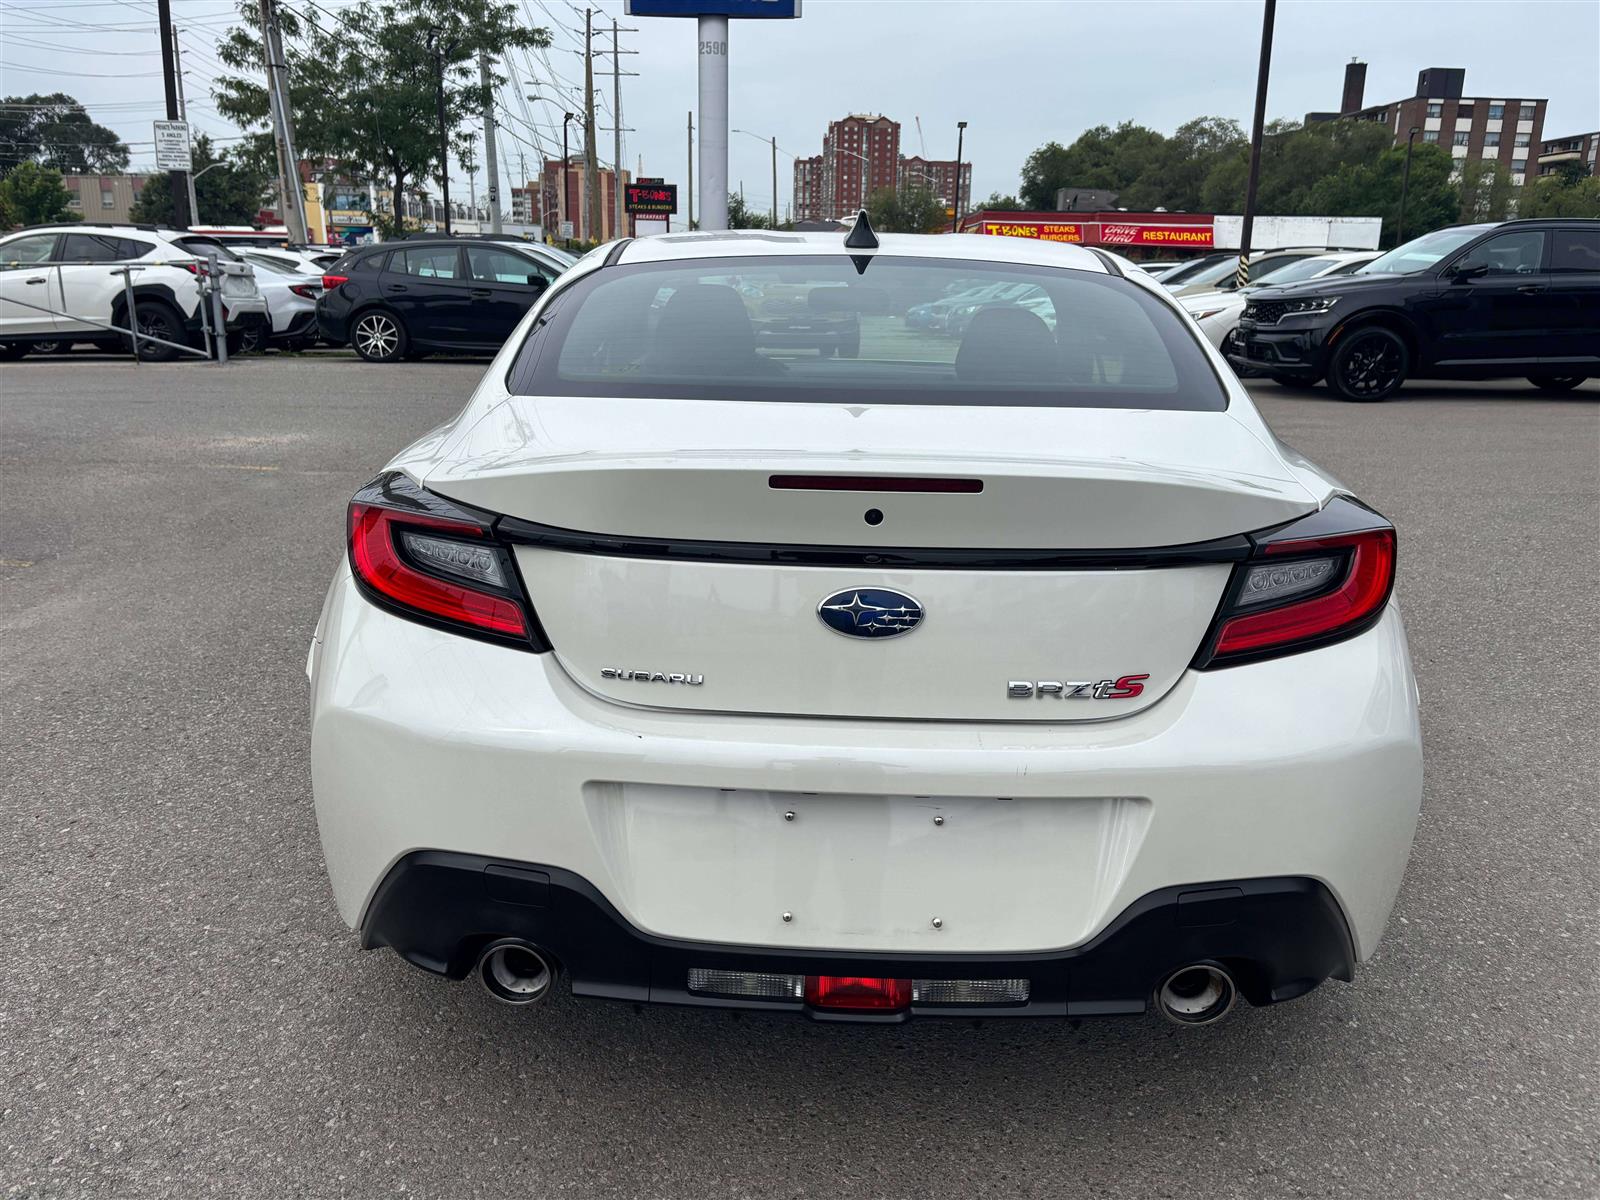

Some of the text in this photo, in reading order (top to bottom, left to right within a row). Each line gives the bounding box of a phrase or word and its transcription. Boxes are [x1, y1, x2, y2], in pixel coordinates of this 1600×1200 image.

[699, 41, 727, 55] 2590
[986, 225, 1038, 237] T-BONES
[1043, 225, 1075, 233] STEAKS
[1104, 225, 1140, 235] DRIVE
[1103, 233, 1135, 243] THRU
[1142, 231, 1212, 242] RESTAURANT
[600, 667, 704, 686] SUBARU
